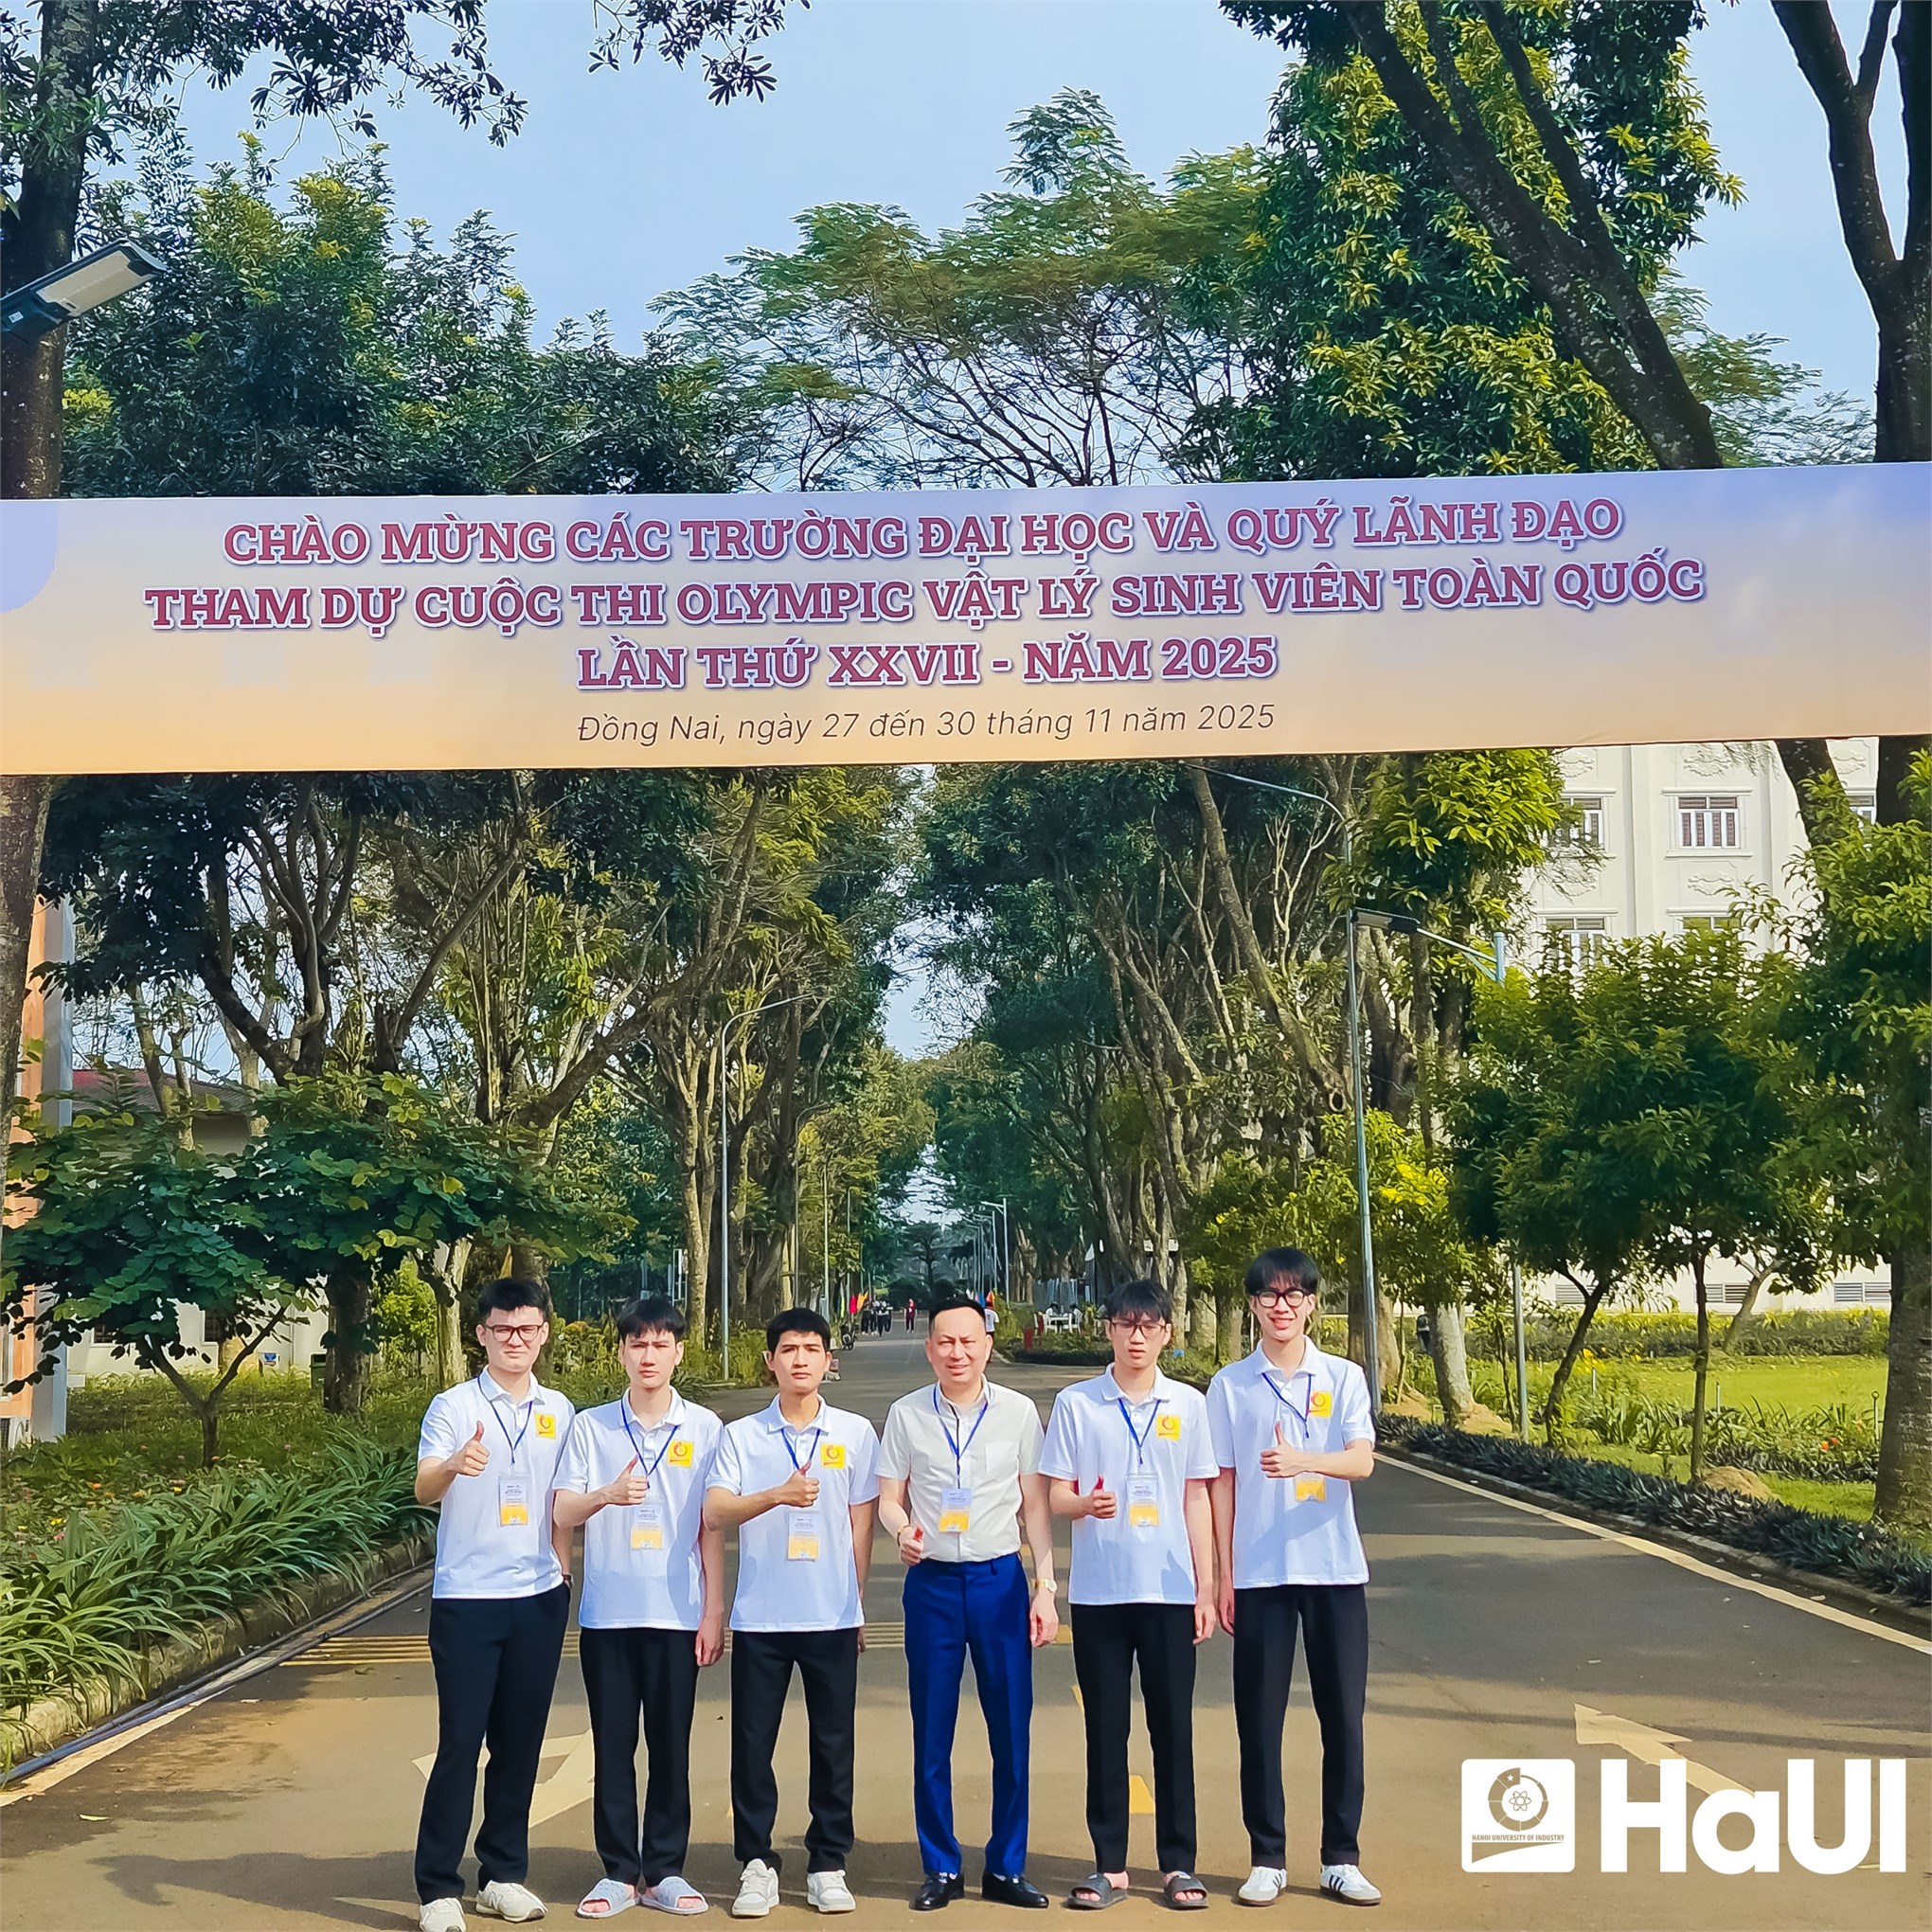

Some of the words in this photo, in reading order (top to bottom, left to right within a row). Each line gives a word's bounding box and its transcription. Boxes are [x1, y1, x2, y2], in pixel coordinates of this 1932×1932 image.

[223, 512, 369, 564] CHÀO
[380, 512, 554, 563] MỪNG
[564, 510, 670, 561] CÁC
[679, 509, 906, 559] TRƯỜNG
[918, 514, 1009, 564] ĐẠI
[1019, 511, 1132, 563] HỌC
[1142, 500, 1216, 550] VÀ
[1225, 497, 1340, 553] QUÝ
[1352, 495, 1500, 546] LÃNH
[1512, 497, 1621, 549] ĐẠO
[143, 586, 310, 629] THAM
[320, 585, 404, 637] DỰ
[413, 576, 560, 635] CUỘC
[569, 582, 665, 624] THI
[676, 580, 911, 623] OLYMPIC
[921, 569, 1028, 629] VẬT
[1038, 567, 1098, 617] LÝ
[1111, 573, 1240, 616] SINH
[1251, 561, 1382, 612] VIÊN
[1391, 557, 1541, 608] TOÀN
[1552, 545, 1704, 609] QUỐC
[578, 635, 687, 689] LẦN
[694, 637, 817, 687] THỨ
[828, 642, 979, 686] XXVII
[1022, 632, 1150, 682] NĂM
[1160, 635, 1275, 678] 2025
[578, 713, 658, 747] Đồng
[670, 715, 724, 744] Nai,
[738, 712, 813, 745] ngày
[822, 713, 860, 738] 27
[869, 711, 924, 737] đến
[937, 711, 975, 736] 30
[987, 710, 1072, 741] tháng
[1085, 708, 1111, 733] 11
[1123, 707, 1186, 732] năm
[1197, 704, 1275, 730] 2025
